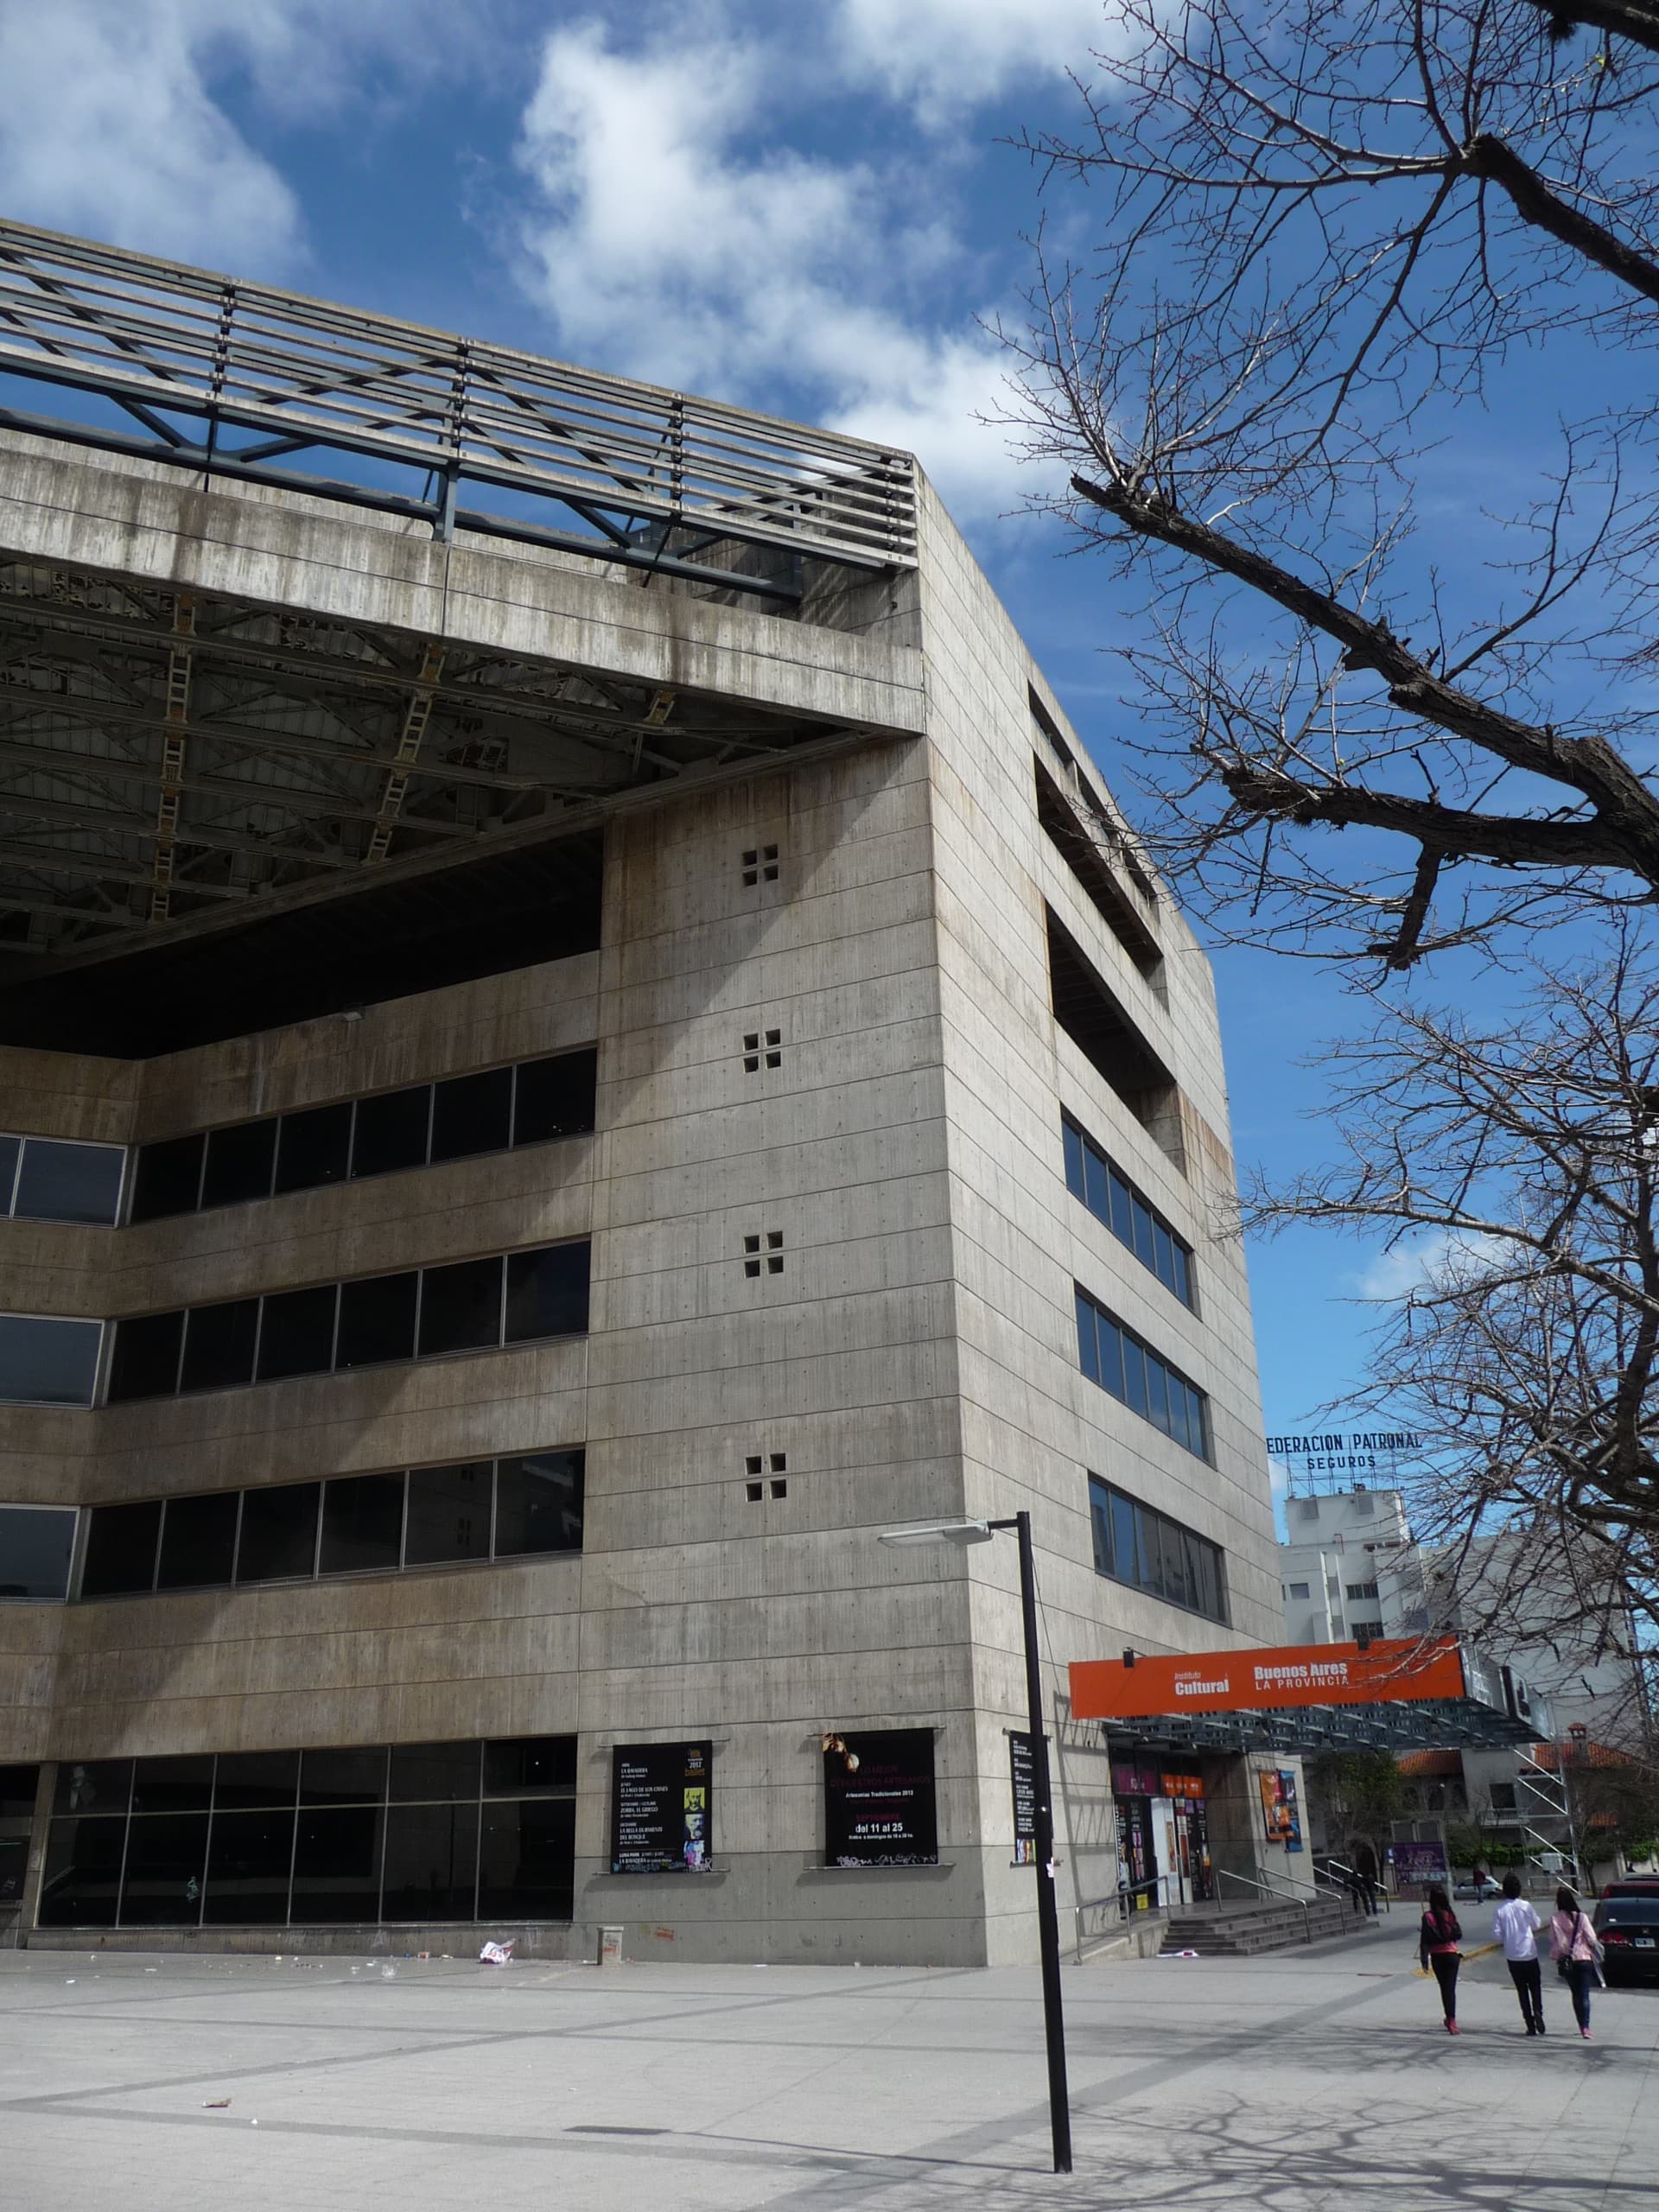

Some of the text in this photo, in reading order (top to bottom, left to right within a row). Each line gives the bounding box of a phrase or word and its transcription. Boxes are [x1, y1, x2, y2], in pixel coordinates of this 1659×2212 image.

[1266, 1432, 1423, 1454] EDERACION PATRONAL
[1307, 1455, 1376, 1470] SEGUROS
[1174, 1671, 1202, 1681] Instituto
[1254, 1662, 1348, 1681] Buenos Aires
[1175, 1679, 1230, 1695] Cultural
[1255, 1675, 1349, 1691] LA PROVINCIA
[855, 1822, 903, 1833] del 11 al 25
